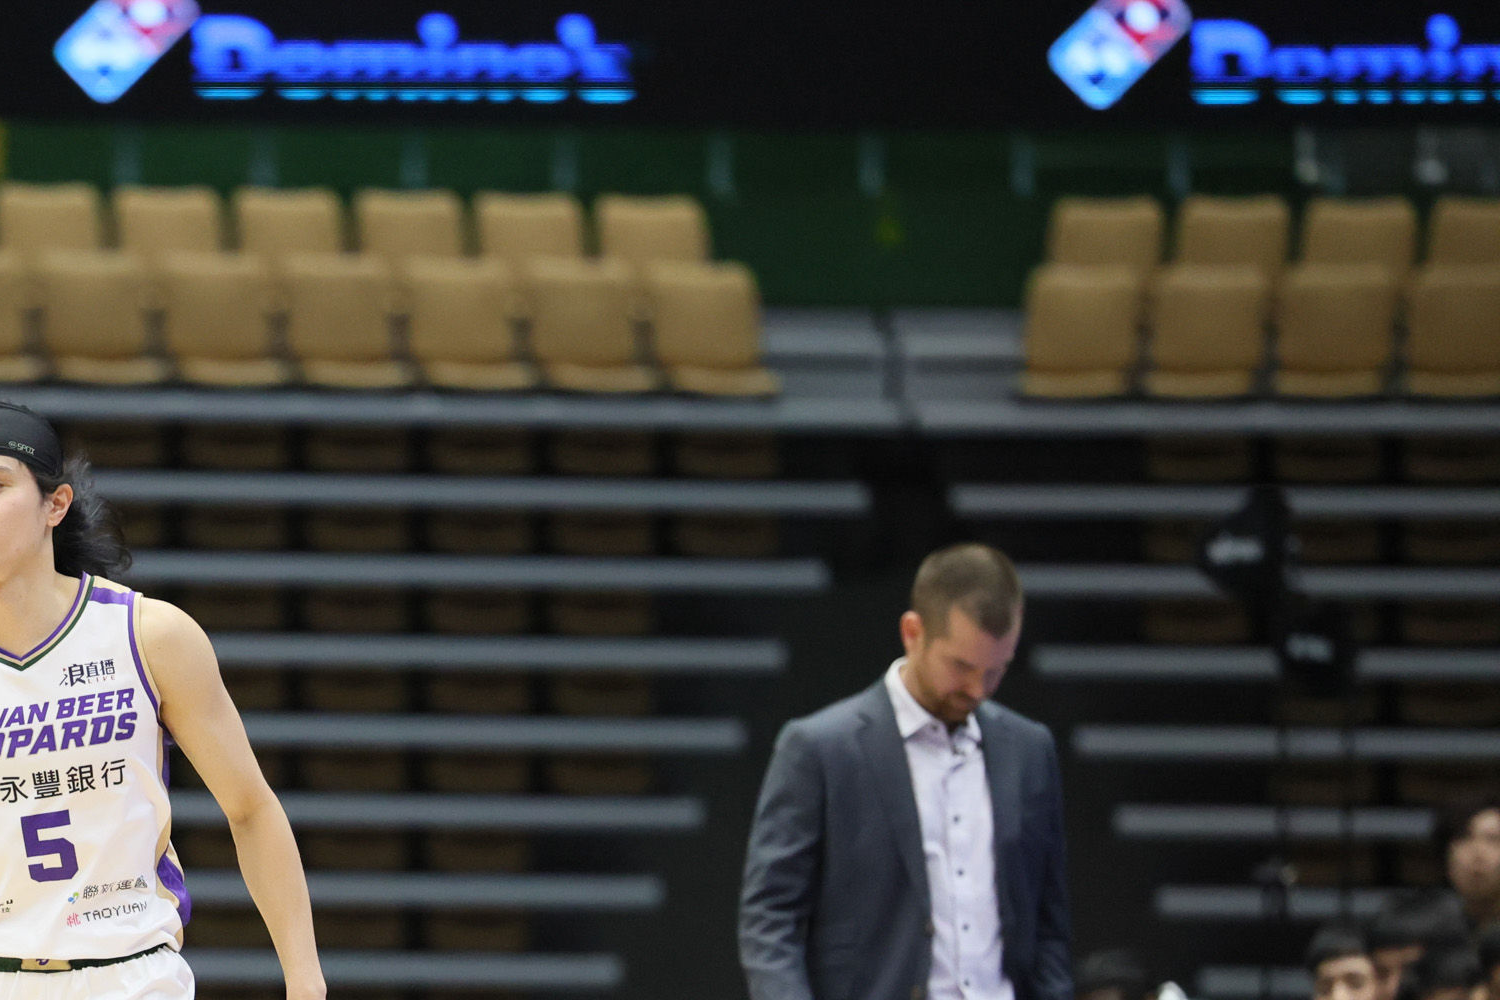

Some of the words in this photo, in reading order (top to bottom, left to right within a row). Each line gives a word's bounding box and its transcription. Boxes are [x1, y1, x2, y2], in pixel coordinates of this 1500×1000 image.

[56, 688, 135, 720] BEER
[0, 759, 126, 803] 永豐銀行
[20, 809, 79, 882] 5
